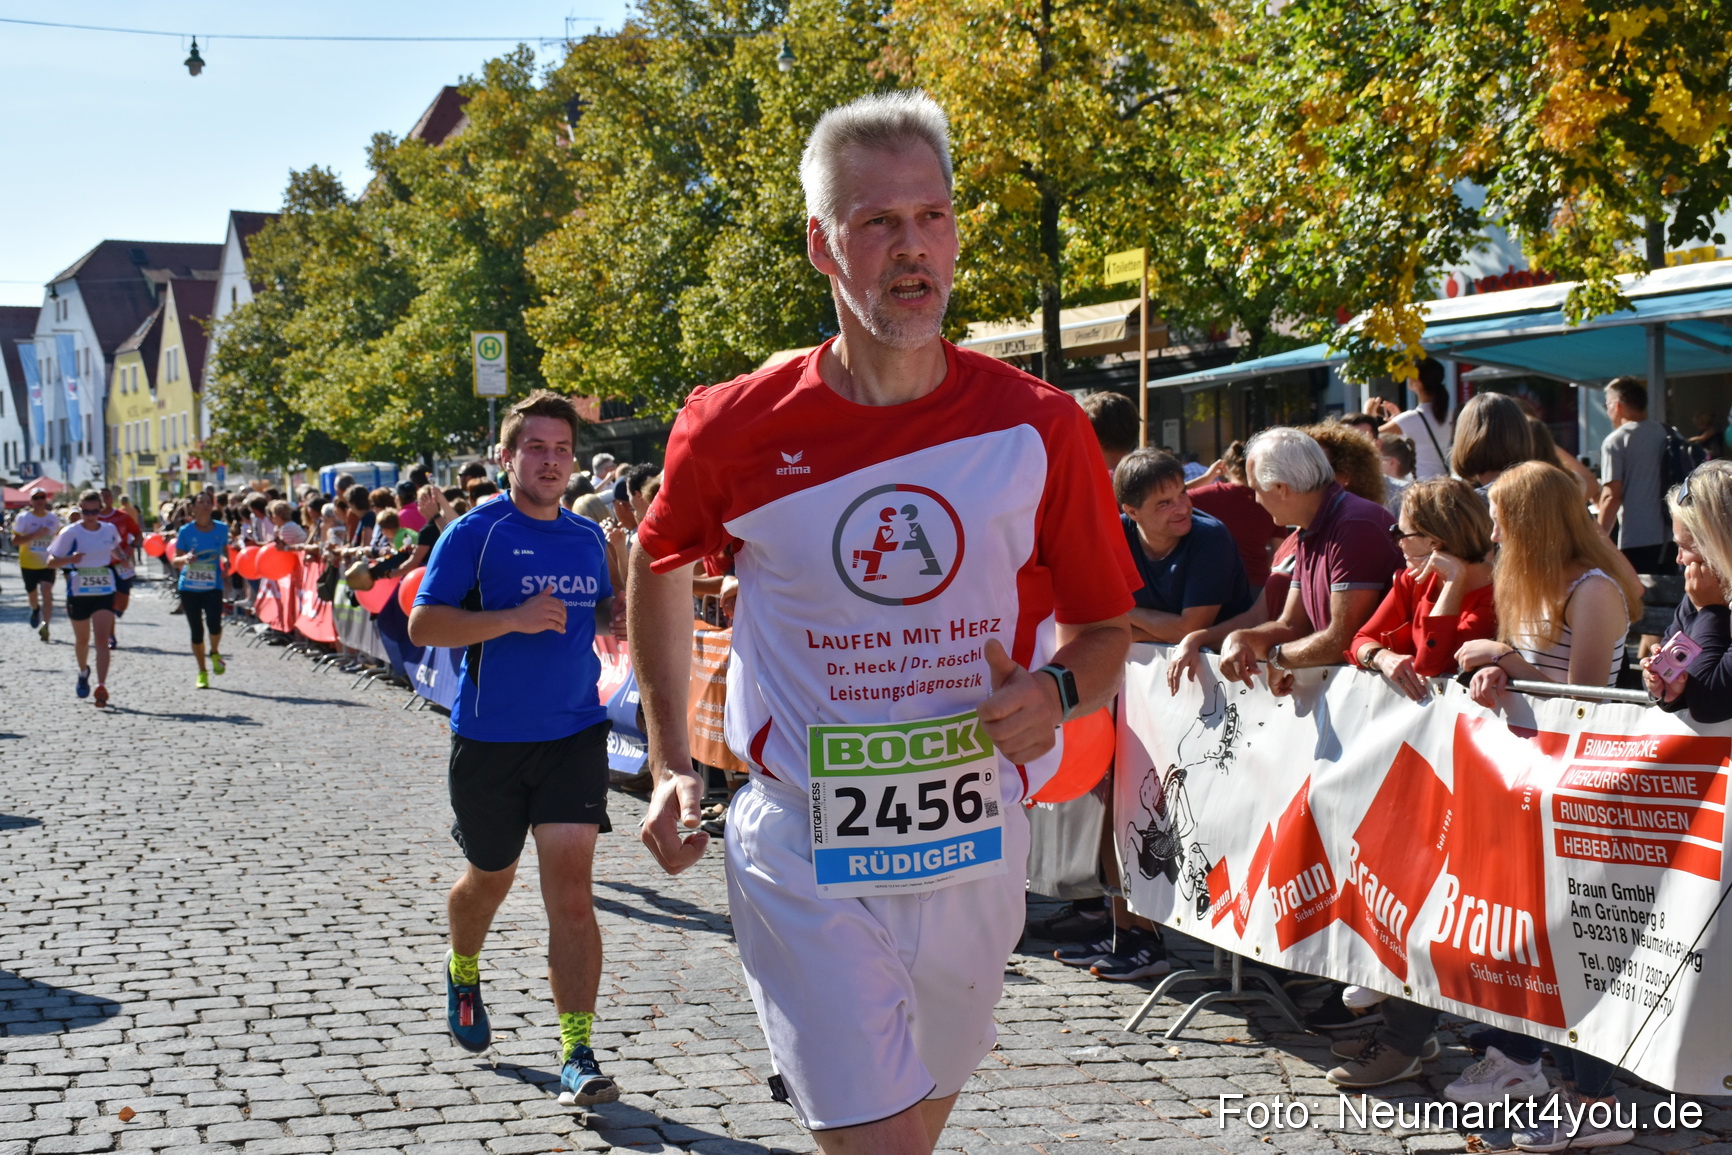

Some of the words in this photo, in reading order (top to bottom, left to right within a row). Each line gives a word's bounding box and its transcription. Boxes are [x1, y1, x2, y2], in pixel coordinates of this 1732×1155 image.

[1112, 259, 1142, 275] Toiletten
[776, 464, 811, 475] erima
[82, 577, 108, 586] 2545
[521, 575, 598, 594] SYSCAD
[827, 662, 850, 675] Dr.
[854, 660, 896, 674] Heck
[911, 656, 932, 669] Dr.
[937, 647, 982, 668] Röschl
[830, 673, 982, 701] Leistungsdiagnostik
[825, 719, 981, 768] BOCK
[1583, 738, 1660, 758] BINDESTRICKE
[1566, 768, 1698, 795] VERZURRSYSTEME
[834, 772, 983, 837] 2456
[1560, 801, 1690, 830] RUNDSCHLINGEN
[1436, 833, 1446, 851] Seit
[1442, 809, 1453, 832] 1929
[848, 841, 976, 876] RÜDIGER
[1563, 836, 1668, 863] HEBEBÄNDER
[1268, 862, 1331, 925] Braun
[1347, 837, 1408, 942] Braun
[1568, 877, 1607, 899] Braun
[1612, 882, 1656, 904] GmbH
[1295, 905, 1315, 923] Sicher
[1315, 900, 1324, 912] ist
[1430, 872, 1540, 967] Braun
[1570, 900, 1591, 919] Am
[1595, 903, 1657, 931] Grünberg
[1659, 911, 1665, 929] 8
[1379, 930, 1389, 945] ist
[1572, 921, 1628, 944] D-92318
[1631, 927, 1703, 973] Neumarkt-Png
[1470, 962, 1504, 985] Sicher
[1506, 970, 1522, 988] ist
[1525, 975, 1559, 995] sicher
[1578, 952, 1604, 971] Tel.
[1607, 955, 1638, 979] 09181
[1646, 966, 1671, 991] 2307-0
[1584, 973, 1607, 993] Fax
[1610, 977, 1636, 1002] 09181
